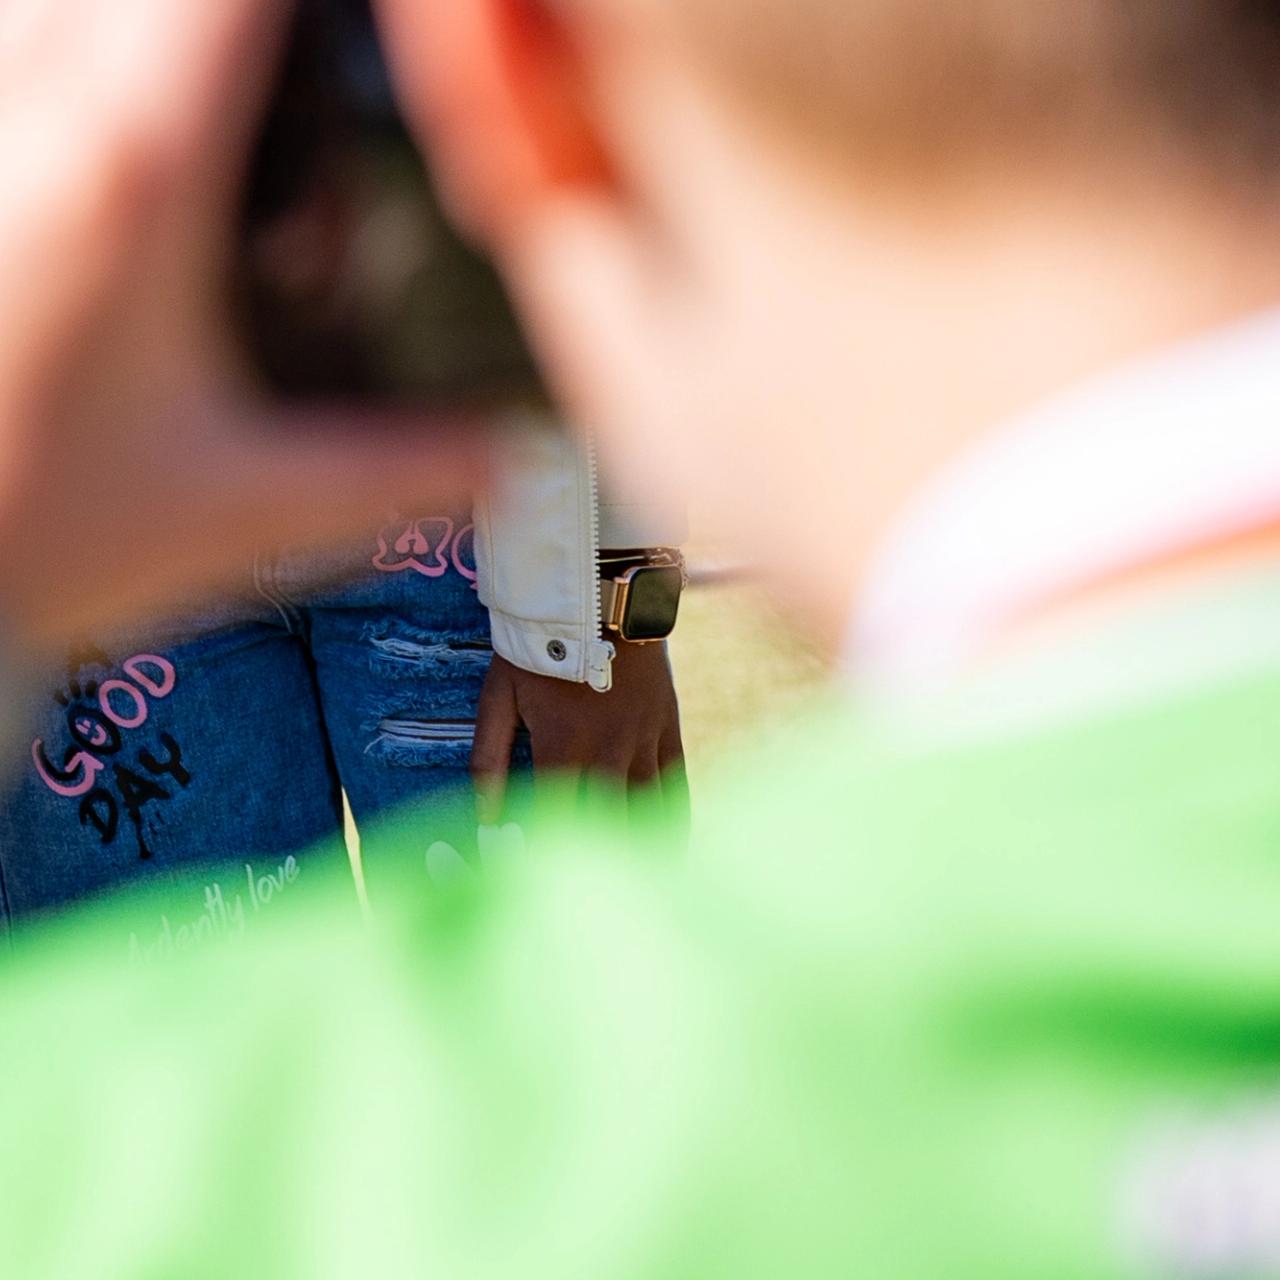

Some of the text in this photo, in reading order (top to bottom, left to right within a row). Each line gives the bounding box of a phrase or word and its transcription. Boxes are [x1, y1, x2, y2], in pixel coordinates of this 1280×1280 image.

[32, 654, 176, 797] GOOD
[79, 732, 190, 859] DAY
[245, 854, 301, 911] love
